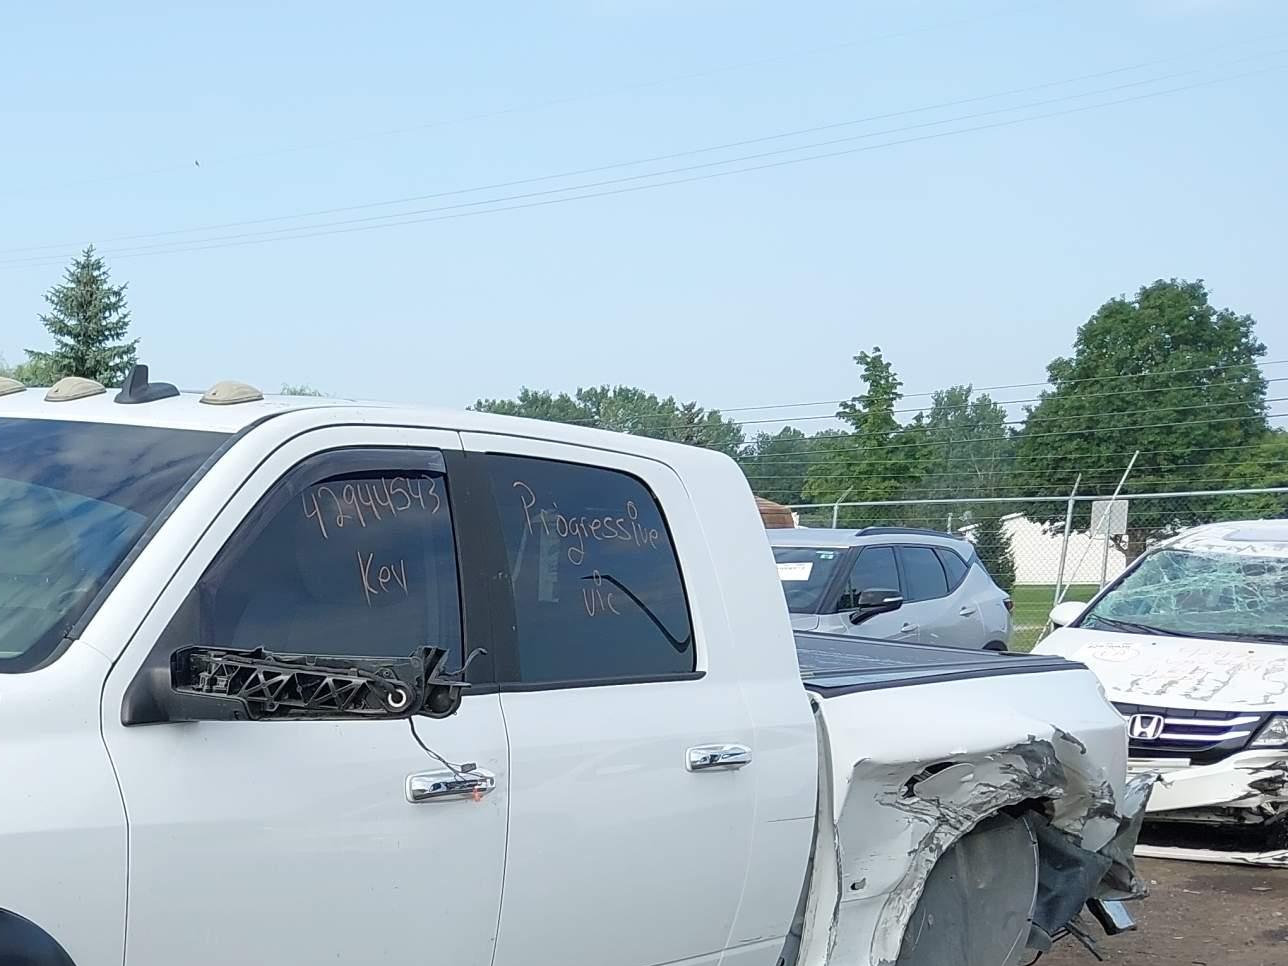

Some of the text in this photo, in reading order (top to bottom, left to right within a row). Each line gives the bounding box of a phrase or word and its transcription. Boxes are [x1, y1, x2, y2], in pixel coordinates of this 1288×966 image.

[302, 474, 441, 539] 42944543
[513, 481, 659, 566] Progressive
[357, 551, 408, 608] Kev
